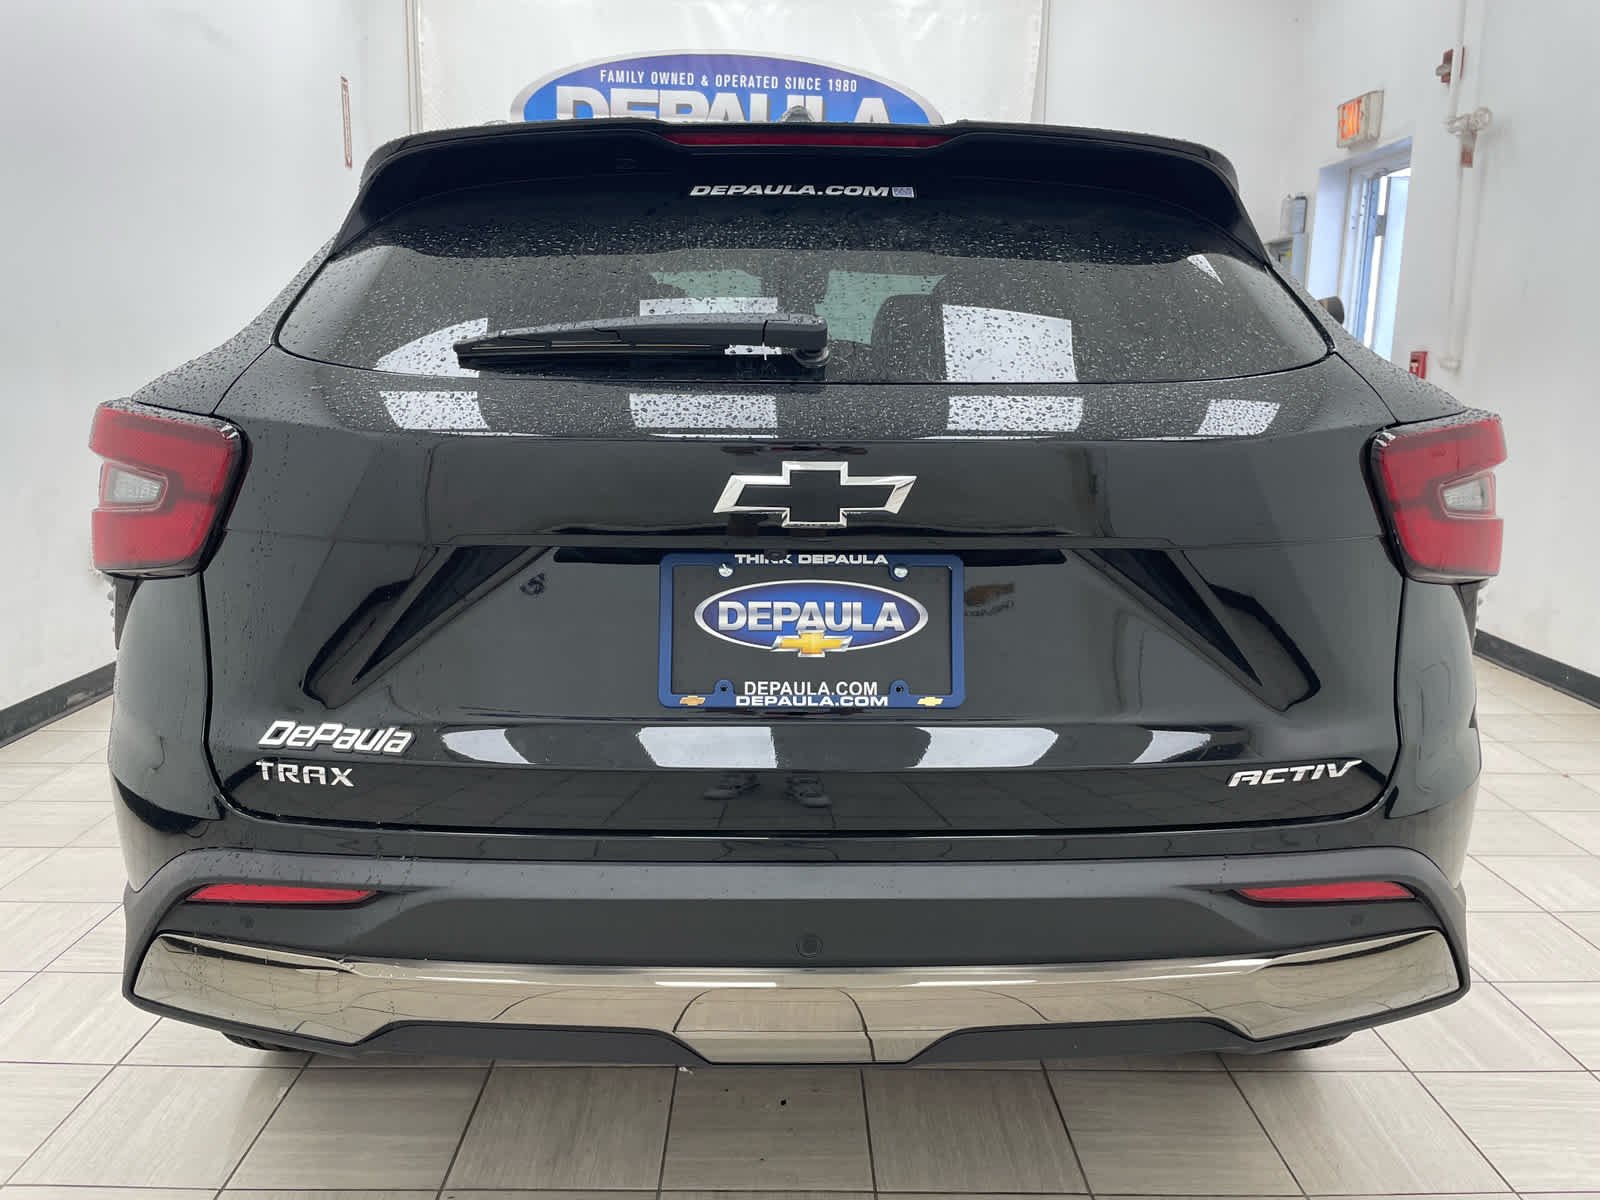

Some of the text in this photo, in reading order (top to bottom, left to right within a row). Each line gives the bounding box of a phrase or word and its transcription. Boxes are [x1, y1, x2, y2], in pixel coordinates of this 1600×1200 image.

[599, 69, 858, 93] FAMILY OWNED & OPERATED SINCE 1980
[690, 185, 889, 197] DEPAULA.COM
[798, 554, 889, 564] DEPAULA
[718, 601, 905, 631] DEPAULA
[744, 681, 878, 696] DEPAULA.COM
[735, 695, 889, 707] DEPAULA.COM
[258, 720, 415, 755] DePaula
[255, 761, 355, 787] TRAX
[1228, 759, 1362, 787] ACTIV
